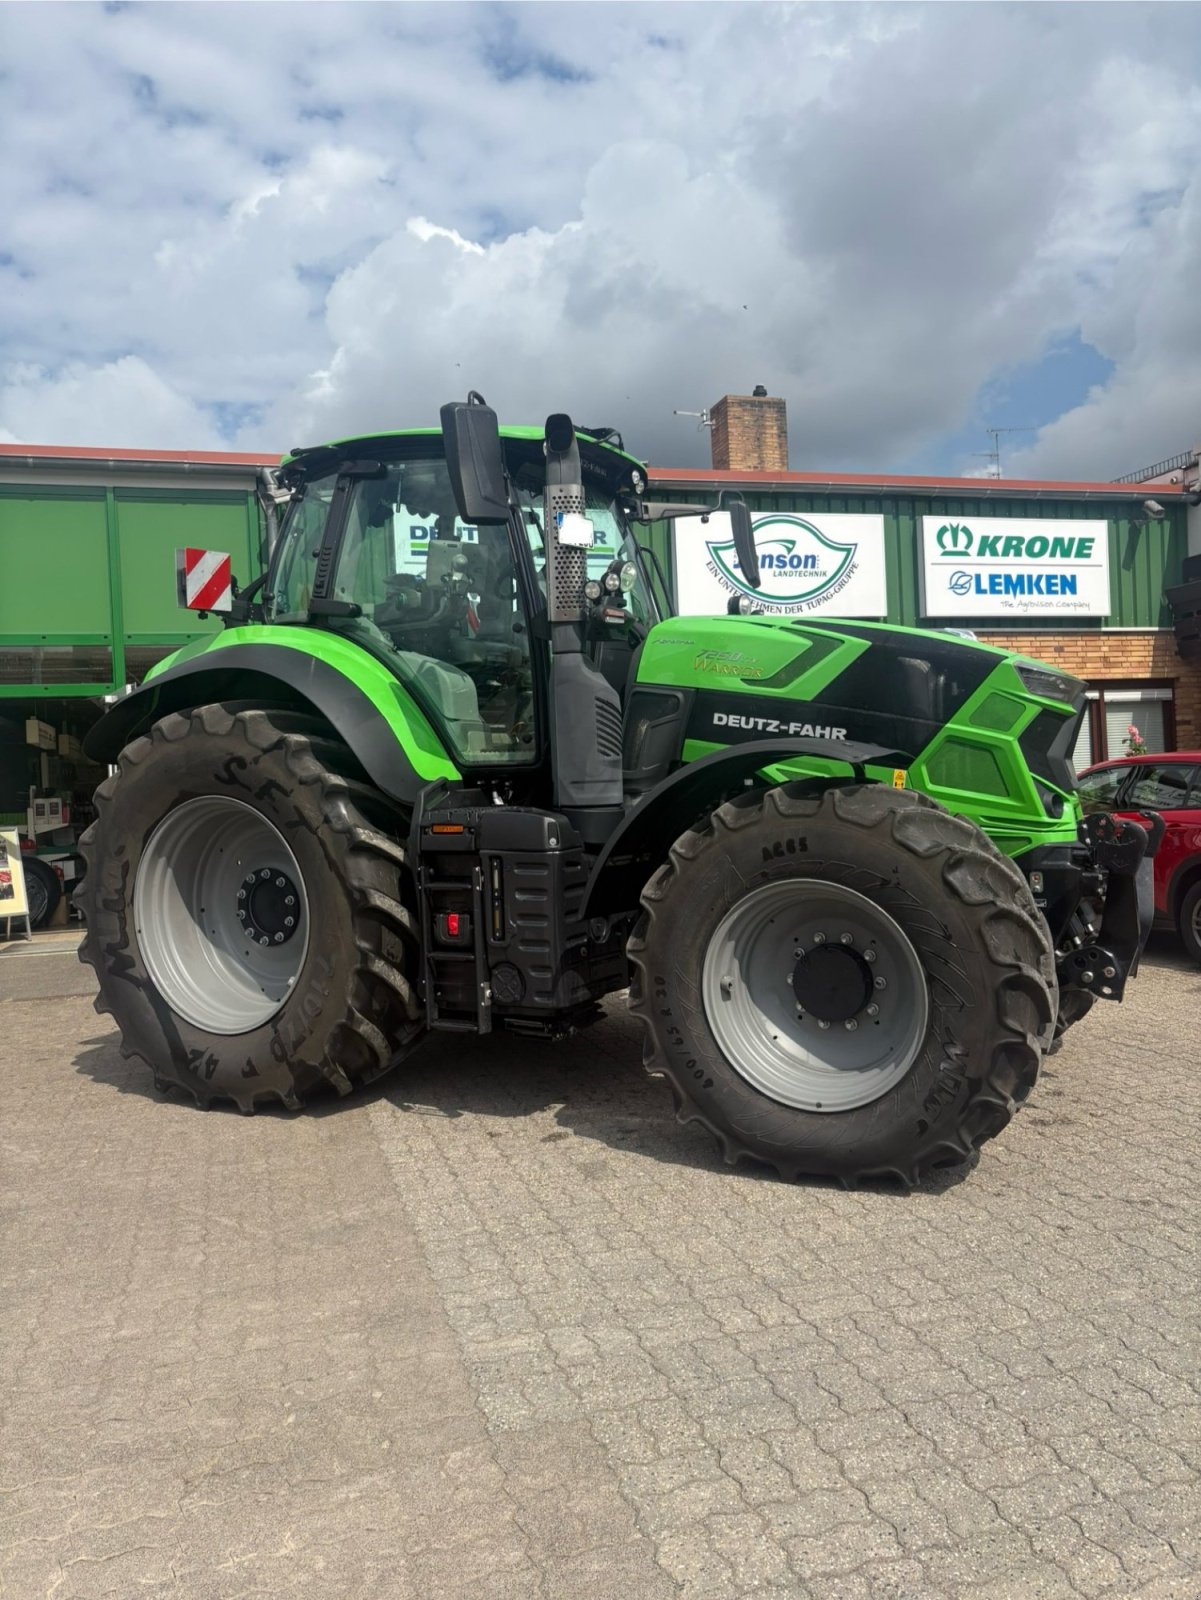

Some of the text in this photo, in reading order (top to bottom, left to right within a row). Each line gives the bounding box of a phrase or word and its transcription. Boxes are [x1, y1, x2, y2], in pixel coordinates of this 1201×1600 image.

[977, 535, 1096, 559] KRONE
[773, 570, 828, 578] LANDTECHNIK
[705, 560, 860, 615] EIN UNTEEHMEN DER TUPAG-GRUPPE
[975, 574, 1078, 600] LEMKEN
[1000, 600, 1014, 608] The
[1056, 600, 1091, 612] Company
[712, 712, 847, 741] DEUTZ-FAHR
